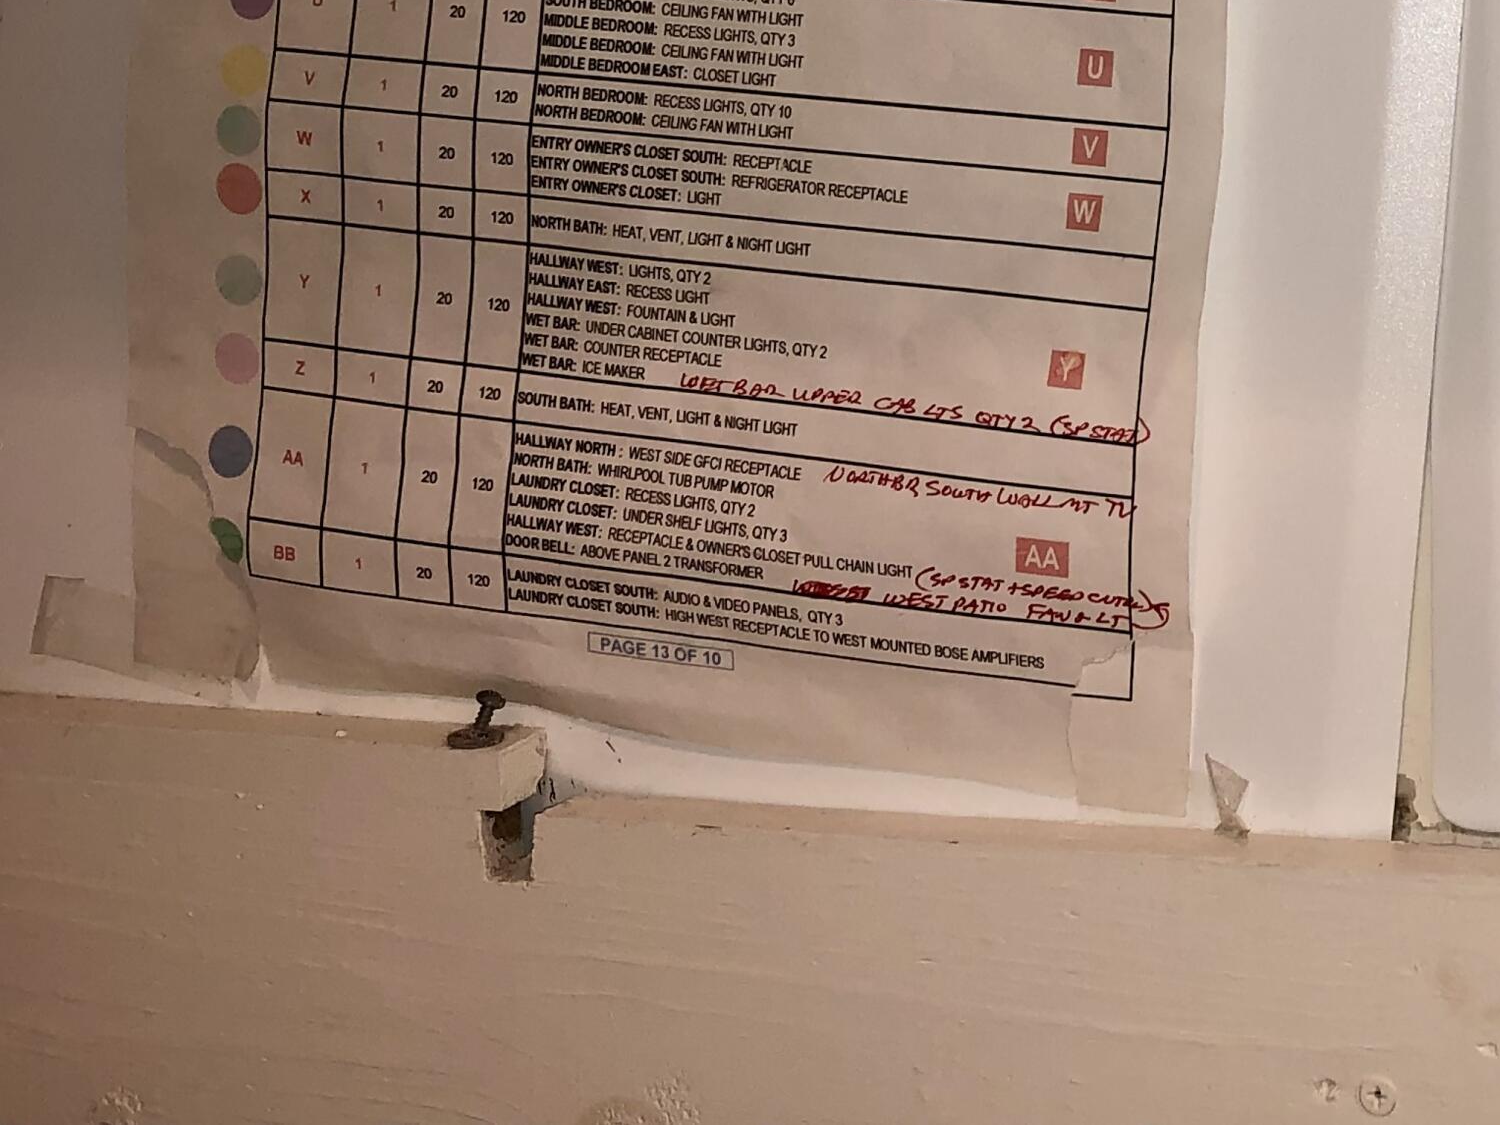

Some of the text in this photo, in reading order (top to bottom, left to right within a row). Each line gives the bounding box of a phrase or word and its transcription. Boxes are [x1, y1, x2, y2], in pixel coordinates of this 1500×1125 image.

[793, 389, 861, 407] UPPER
[1024, 549, 1060, 571] AA
[951, 597, 1006, 614] PATIO
[506, 587, 1044, 669] LAUNDRY CLOSET SOUTH: HIGH WEST RECEPTACLE TO WEST MOUNTED BOSE AMPLIFIERS
[601, 638, 721, 665] PAGE 13 OF 10
